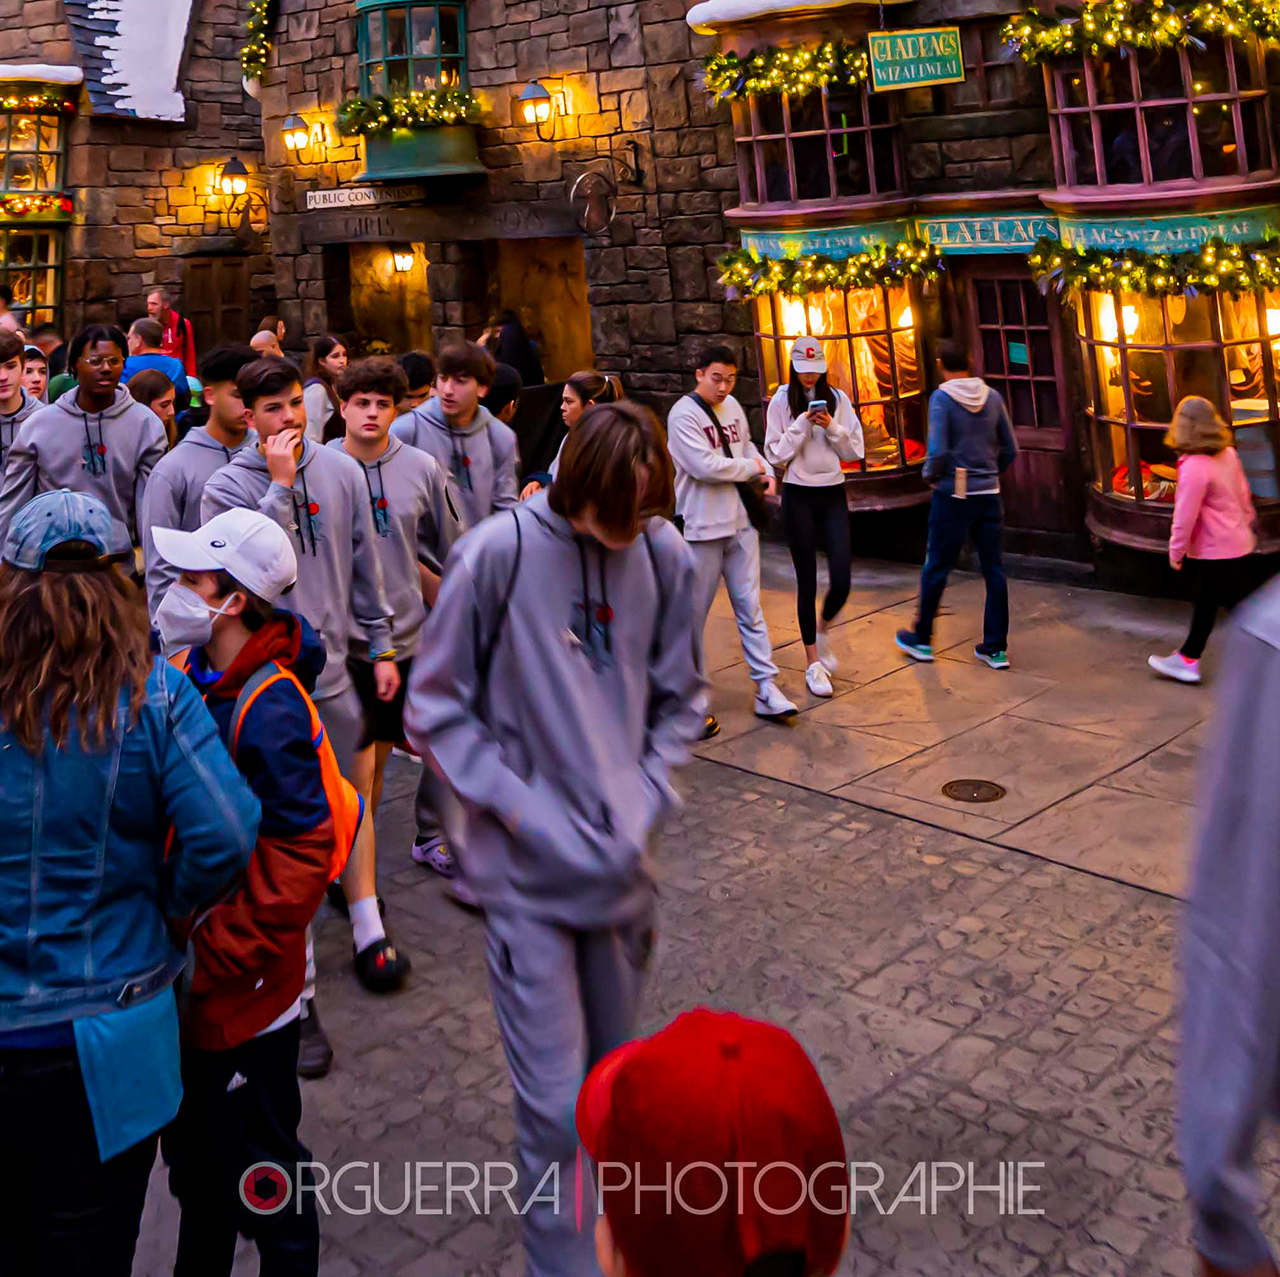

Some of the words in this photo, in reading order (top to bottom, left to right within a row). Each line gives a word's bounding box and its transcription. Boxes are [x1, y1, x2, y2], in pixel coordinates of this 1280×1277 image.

[873, 33, 958, 63] GLADRAGS
[876, 59, 959, 83] WIZARDWEAR
[307, 192, 345, 206] PUBLIC
[344, 215, 396, 239] GIRLS
[923, 218, 1060, 245] GLADRAGS
[806, 347, 816, 359] C
